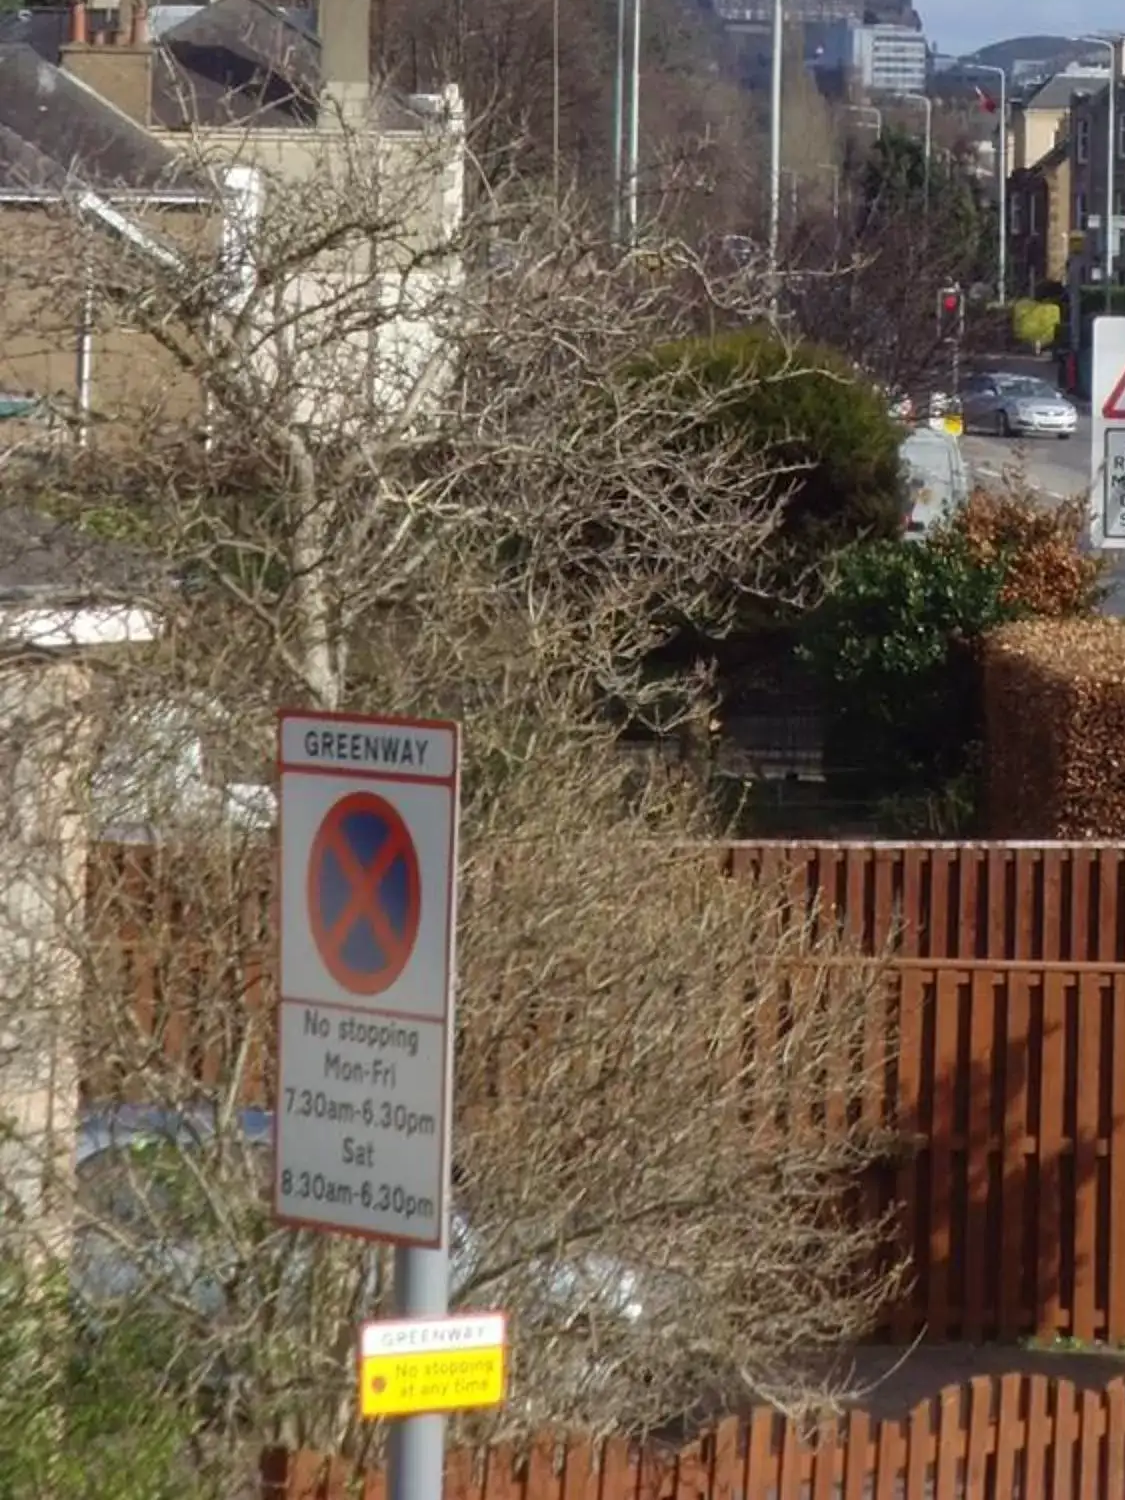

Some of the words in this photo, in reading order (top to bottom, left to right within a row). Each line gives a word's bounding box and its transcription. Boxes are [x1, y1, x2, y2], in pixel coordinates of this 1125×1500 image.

[304, 729, 430, 766] GREENWAY
[303, 1009, 331, 1038] No
[338, 1016, 419, 1056] stopping
[323, 1050, 397, 1089] Mon-Fri
[285, 1087, 435, 1139] 7.30am-6.30pm
[342, 1137, 375, 1168] Sat
[281, 1169, 434, 1219] 8.30am-6.30pm
[381, 1326, 486, 1347] GREENWAY
[396, 1363, 419, 1379] No
[425, 1358, 494, 1376] stopping
[400, 1385, 414, 1398] at
[421, 1381, 451, 1398] any
[455, 1377, 489, 1393] time
